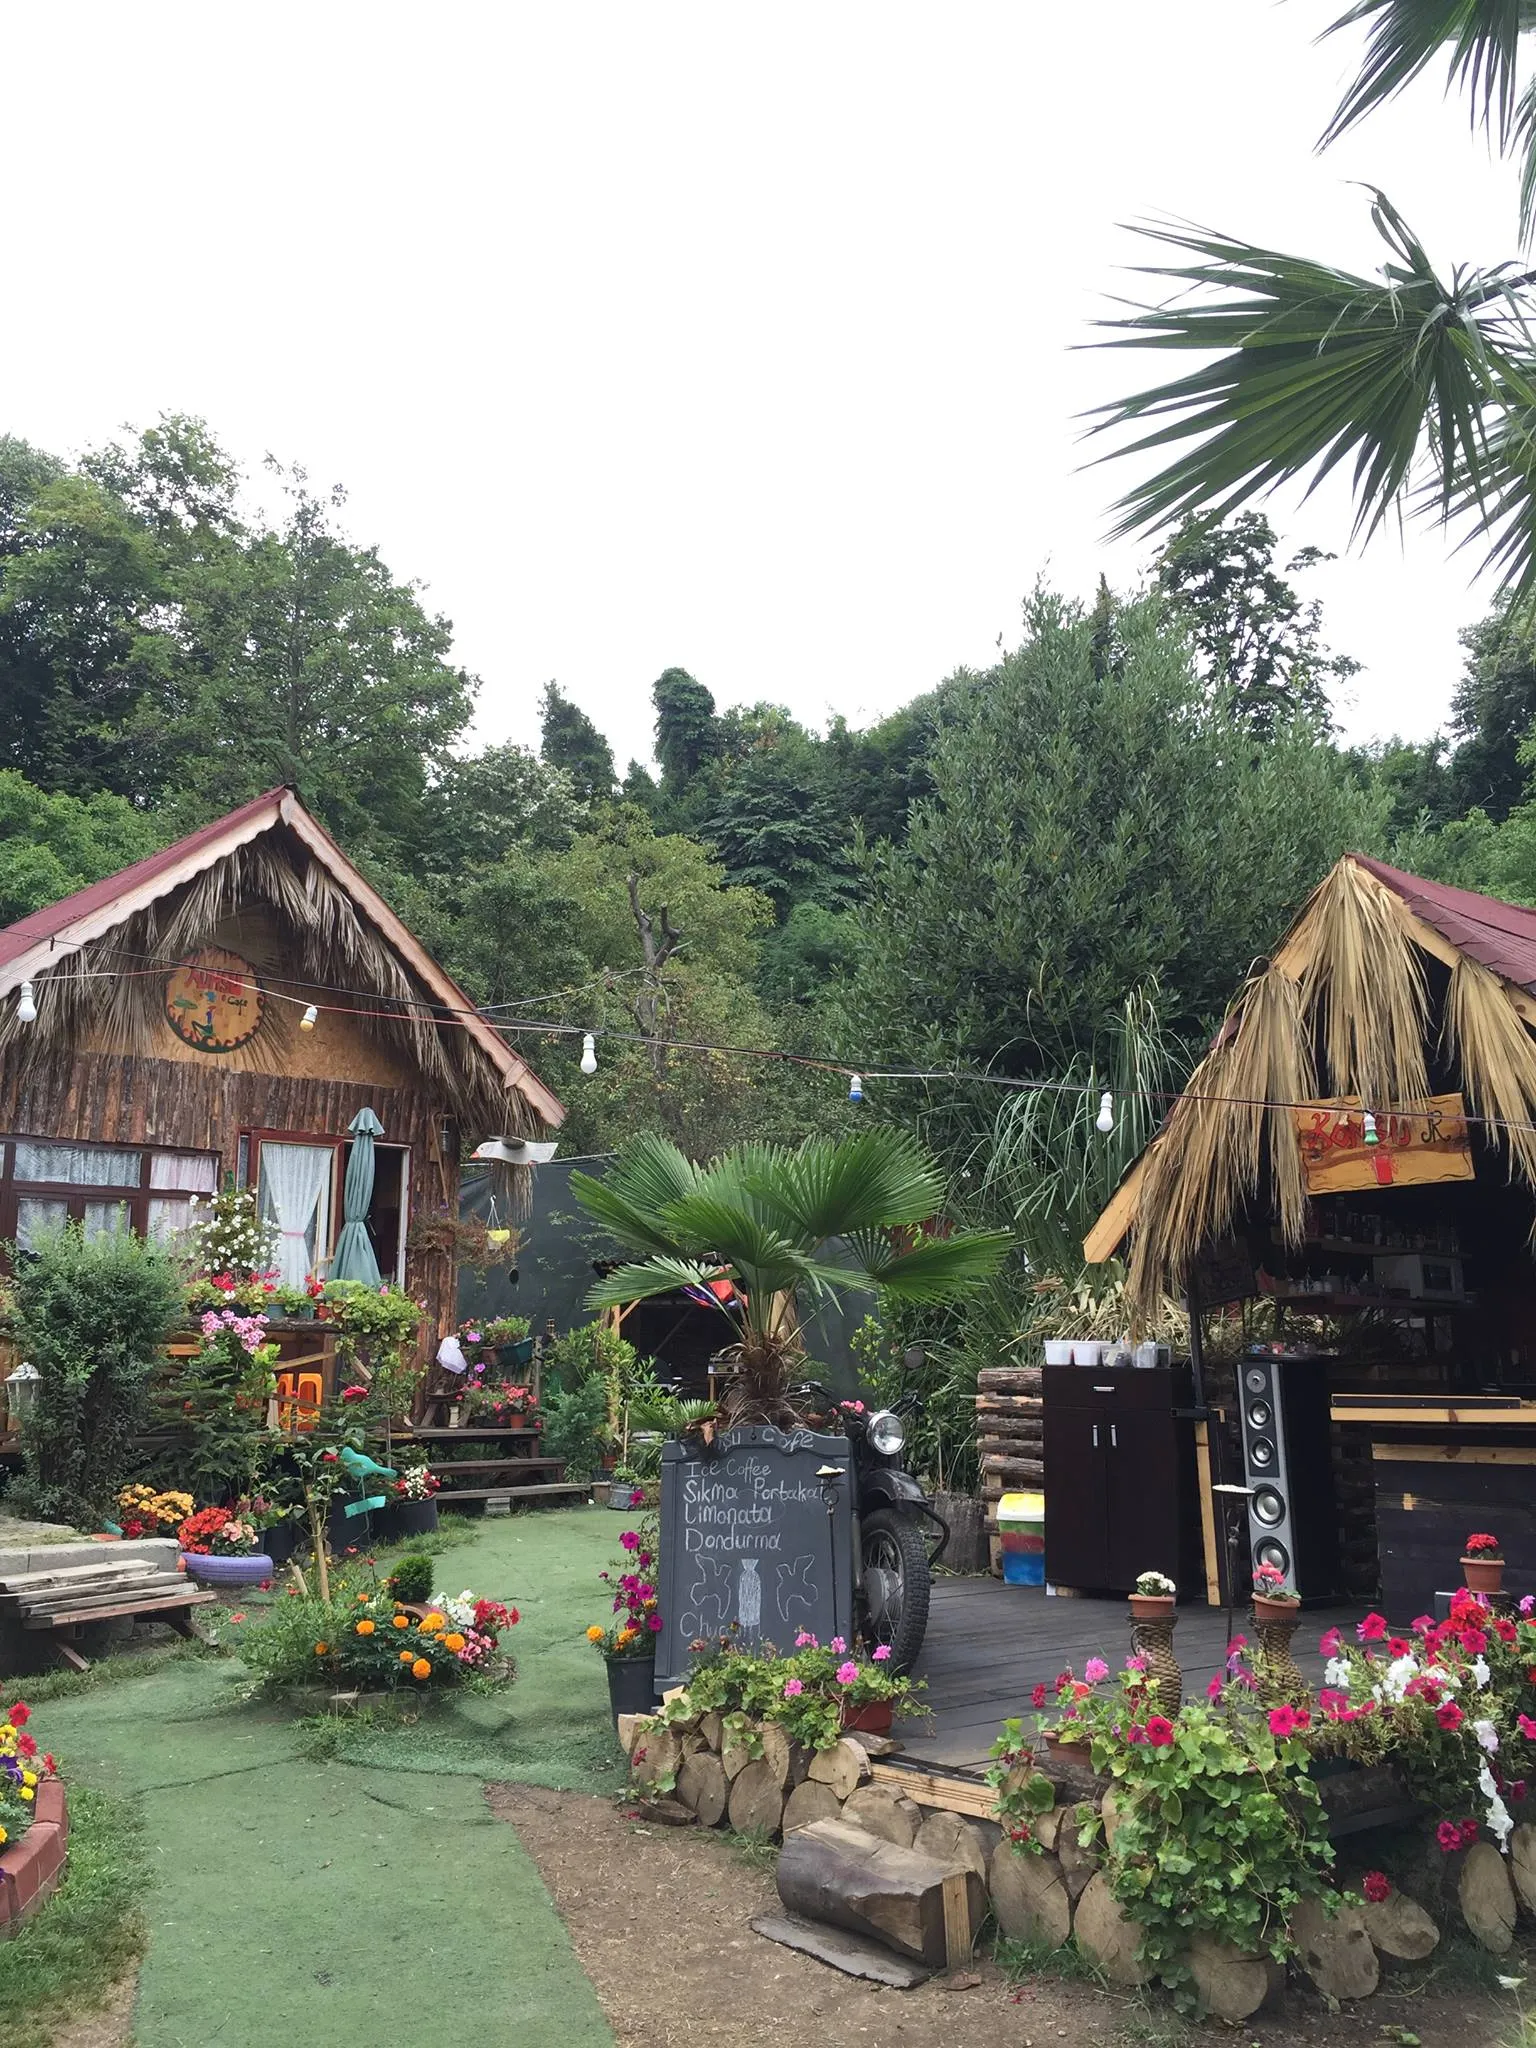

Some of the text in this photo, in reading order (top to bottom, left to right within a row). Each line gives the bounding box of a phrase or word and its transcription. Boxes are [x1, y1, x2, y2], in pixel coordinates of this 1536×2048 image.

[761, 1427, 814, 1452] Cafe
[684, 1456, 772, 1484] Ice Coffee
[684, 1502, 772, 1526] Limonata
[685, 1523, 782, 1552] Dondurma
